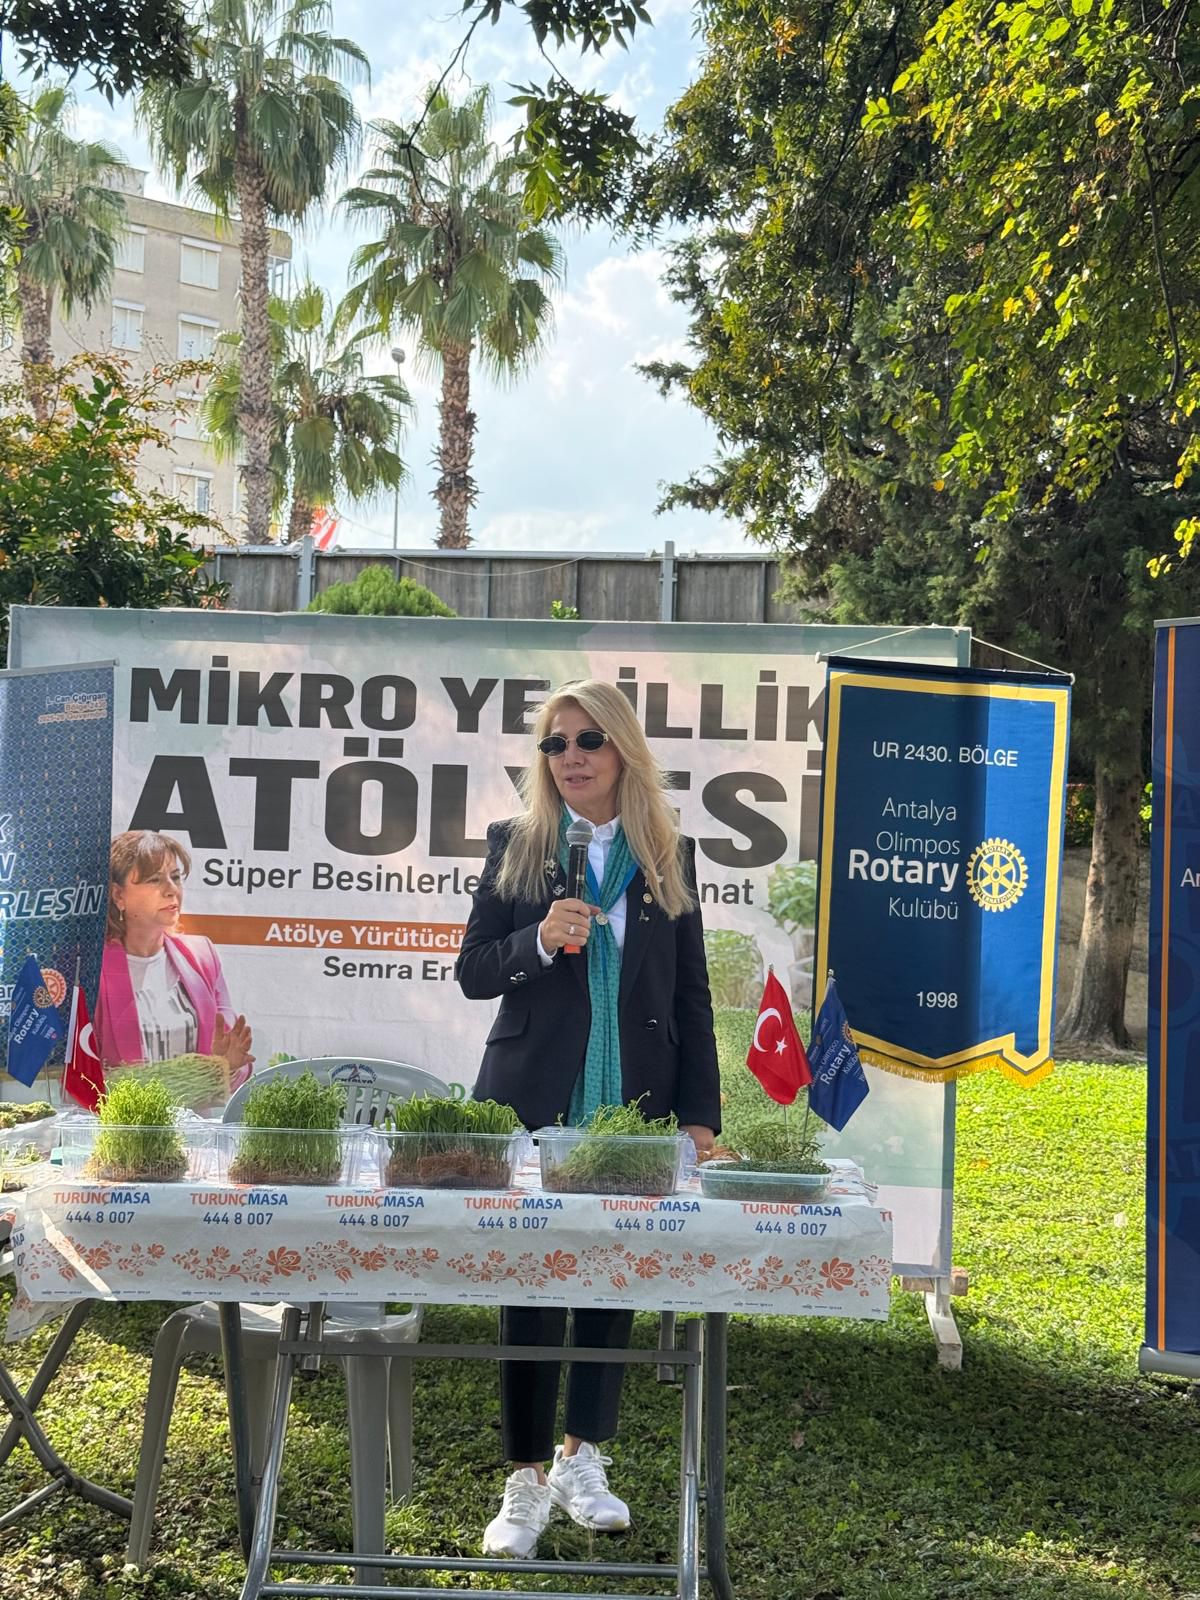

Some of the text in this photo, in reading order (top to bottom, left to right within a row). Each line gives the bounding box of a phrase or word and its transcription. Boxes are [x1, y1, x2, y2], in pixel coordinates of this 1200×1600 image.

[129, 656, 417, 731] MİKRO
[873, 741, 1019, 767] UR 2430. BÖLGE
[882, 797, 957, 826] Antalya
[876, 831, 960, 859] Olimpos
[202, 858, 301, 894] Süper
[313, 862, 480, 895] Besinlerle
[848, 849, 959, 892] Rotary
[889, 897, 958, 920] Kulübü
[265, 922, 343, 948] Atölye
[323, 956, 412, 980] Semra
[916, 990, 958, 1009] 1998
[14, 1008, 39, 1044] Rotary
[820, 1044, 851, 1085] Rotary
[54, 1191, 151, 1206] TURUNÇMASA
[190, 1192, 288, 1207] TURUNÇMASA
[326, 1194, 424, 1208] TURUNÇMASA
[464, 1197, 563, 1211] TURUNÇMASA
[600, 1200, 700, 1213] TURUNÇMASA
[66, 1211, 135, 1224] 444 8 007
[203, 1212, 273, 1225] 444 8 007
[740, 1202, 843, 1218] TURUNÇMASA
[339, 1214, 409, 1227] 444 8 007
[478, 1216, 548, 1229] 444 8 007
[615, 1218, 685, 1232] 444 8 007
[755, 1220, 827, 1236] 444 8 007
